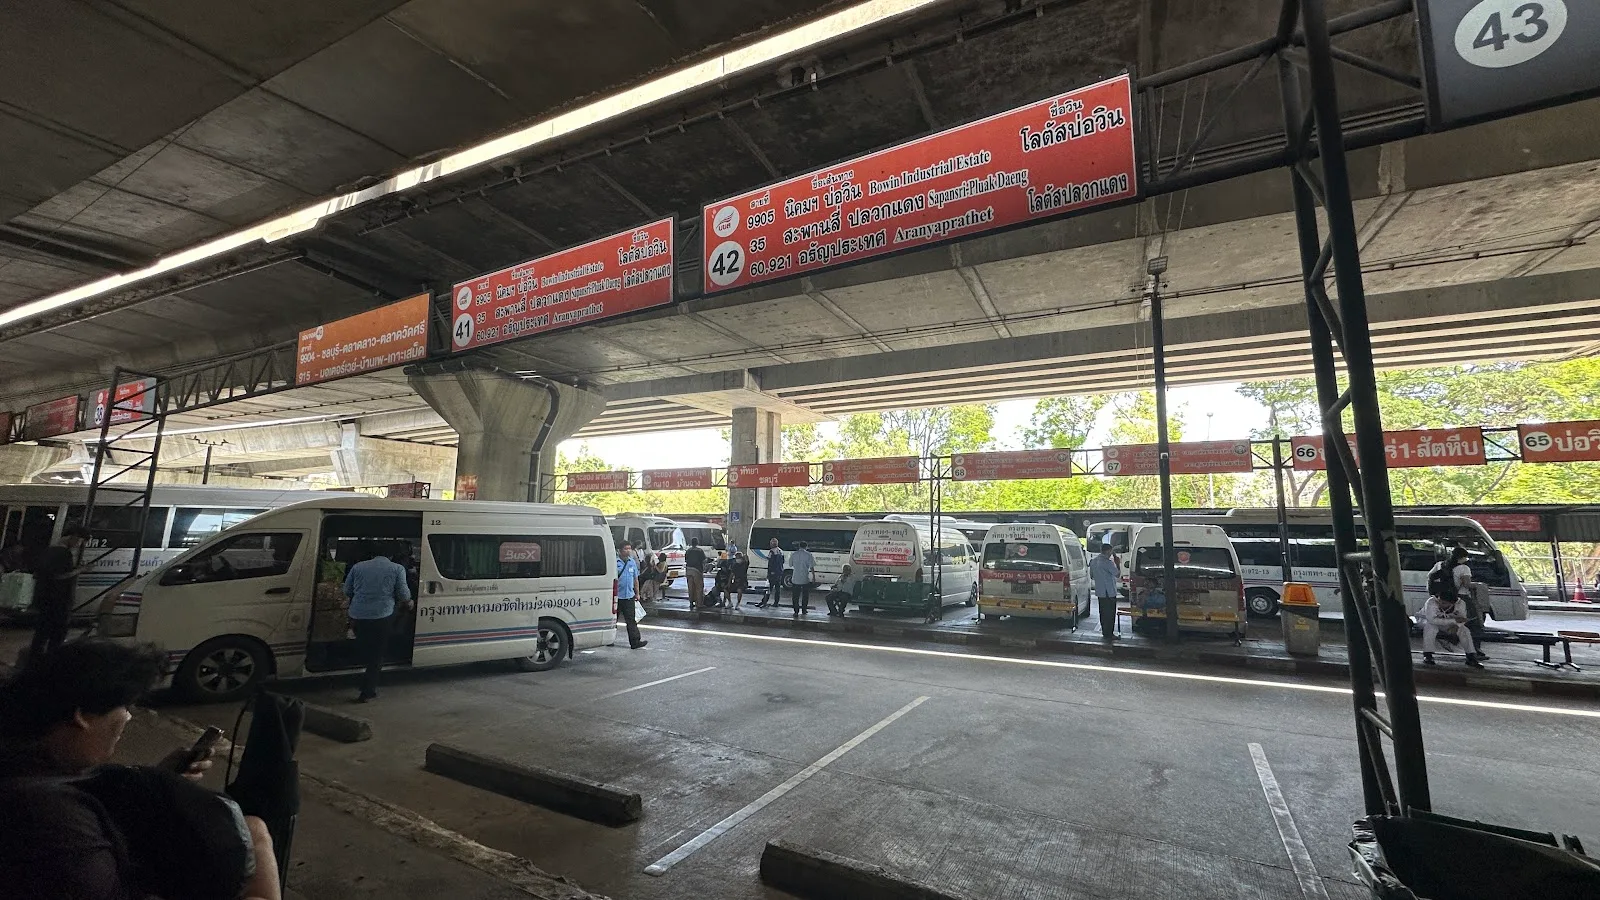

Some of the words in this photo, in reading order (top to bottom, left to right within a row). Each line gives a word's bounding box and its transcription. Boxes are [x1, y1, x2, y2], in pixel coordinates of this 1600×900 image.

[1472, 2, 1549, 51] 43
[1050, 100, 1082, 116] ชื่อวิน
[1021, 107, 1124, 151] โลตัสบ่อวิน
[749, 211, 774, 228] 9905
[785, 199, 818, 217] นิคมฯ
[824, 183, 861, 206] บ่อวิน
[869, 177, 900, 195] Bowin
[902, 160, 952, 185] Industrial
[956, 151, 990, 169] Estate
[1028, 174, 1127, 213] โลตัสปลวกแดง
[751, 237, 765, 252] 35
[784, 206, 841, 244] สะพานสี่
[849, 194, 924, 227] ปลวกแดง
[750, 255, 791, 276] 60,921
[799, 229, 886, 265] อรัญประเทศ
[893, 206, 993, 242] Aranyaprathet
[618, 238, 667, 266] โลตัสบ่อวิน
[712, 249, 740, 276] 42
[477, 312, 486, 324] 35
[552, 302, 603, 323] Aranyaprathet
[456, 319, 470, 339] 41
[298, 371, 311, 382] 915
[1525, 435, 1549, 447] 65
[1296, 447, 1315, 458] 66
[1107, 462, 1119, 471] 67
[759, 473, 778, 486] ชลบุรี
[504, 549, 536, 560] BusX
